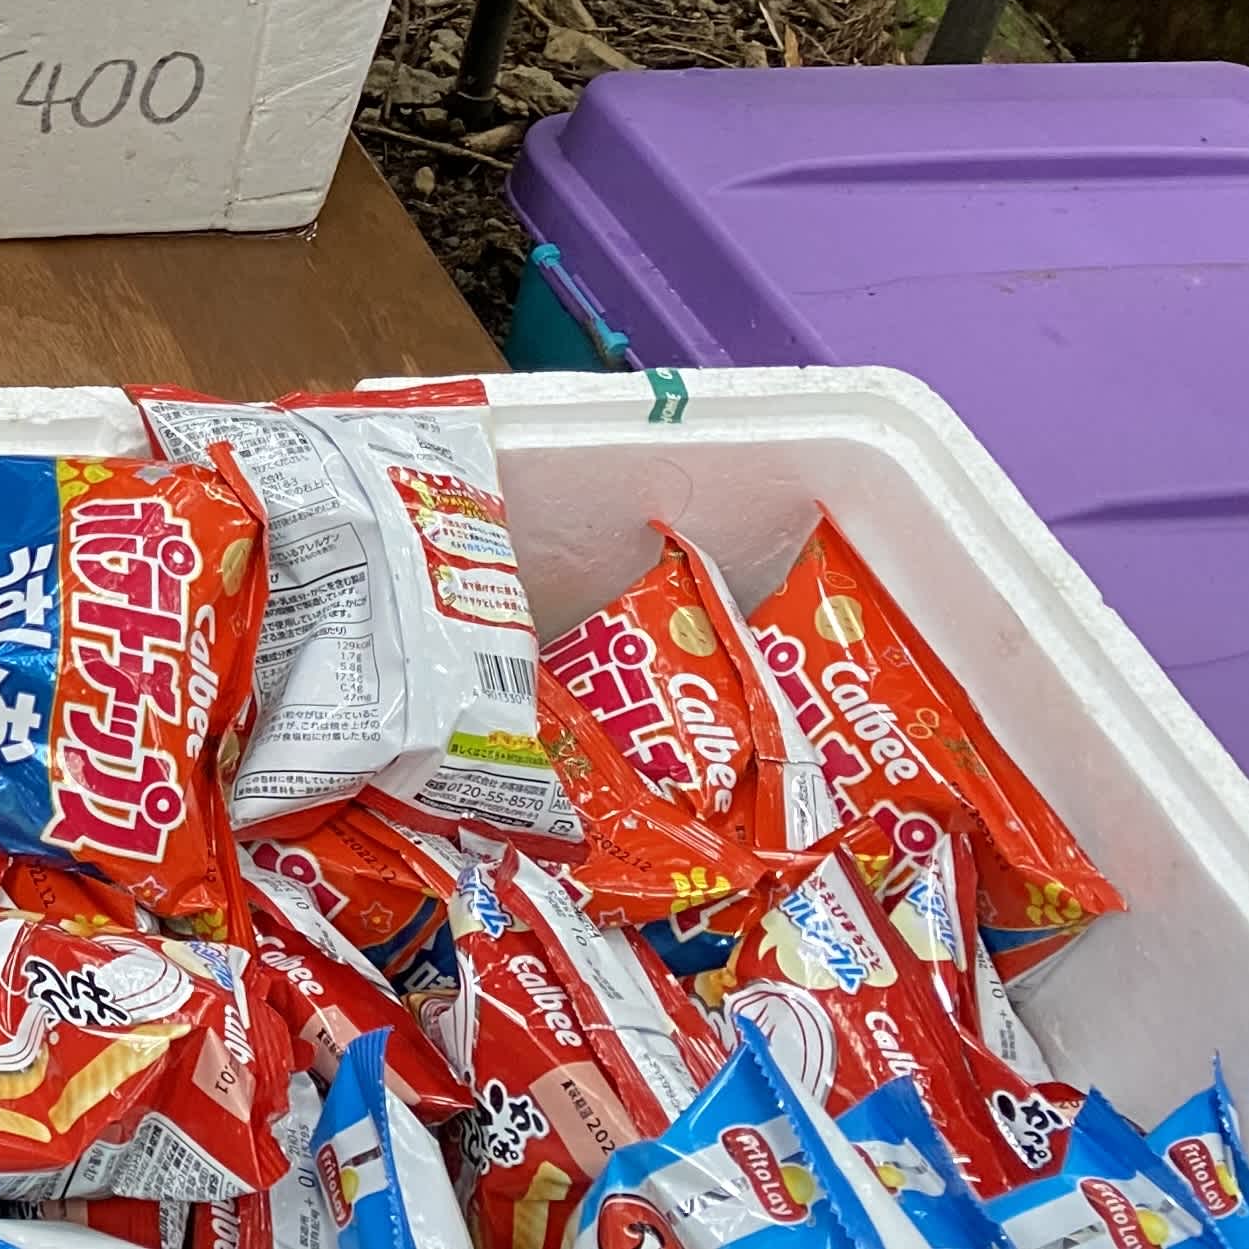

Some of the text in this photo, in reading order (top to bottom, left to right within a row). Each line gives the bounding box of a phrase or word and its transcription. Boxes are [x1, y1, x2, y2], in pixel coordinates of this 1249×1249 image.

[41, 495, 221, 864] ポテトチップス Calbee
[820, 659, 921, 788] Calbee
[445, 782, 546, 812] 0120-55-8570
[666, 671, 740, 816] Calbee
[592, 830, 654, 873] 2022.12
[508, 953, 585, 1051] Calbee
